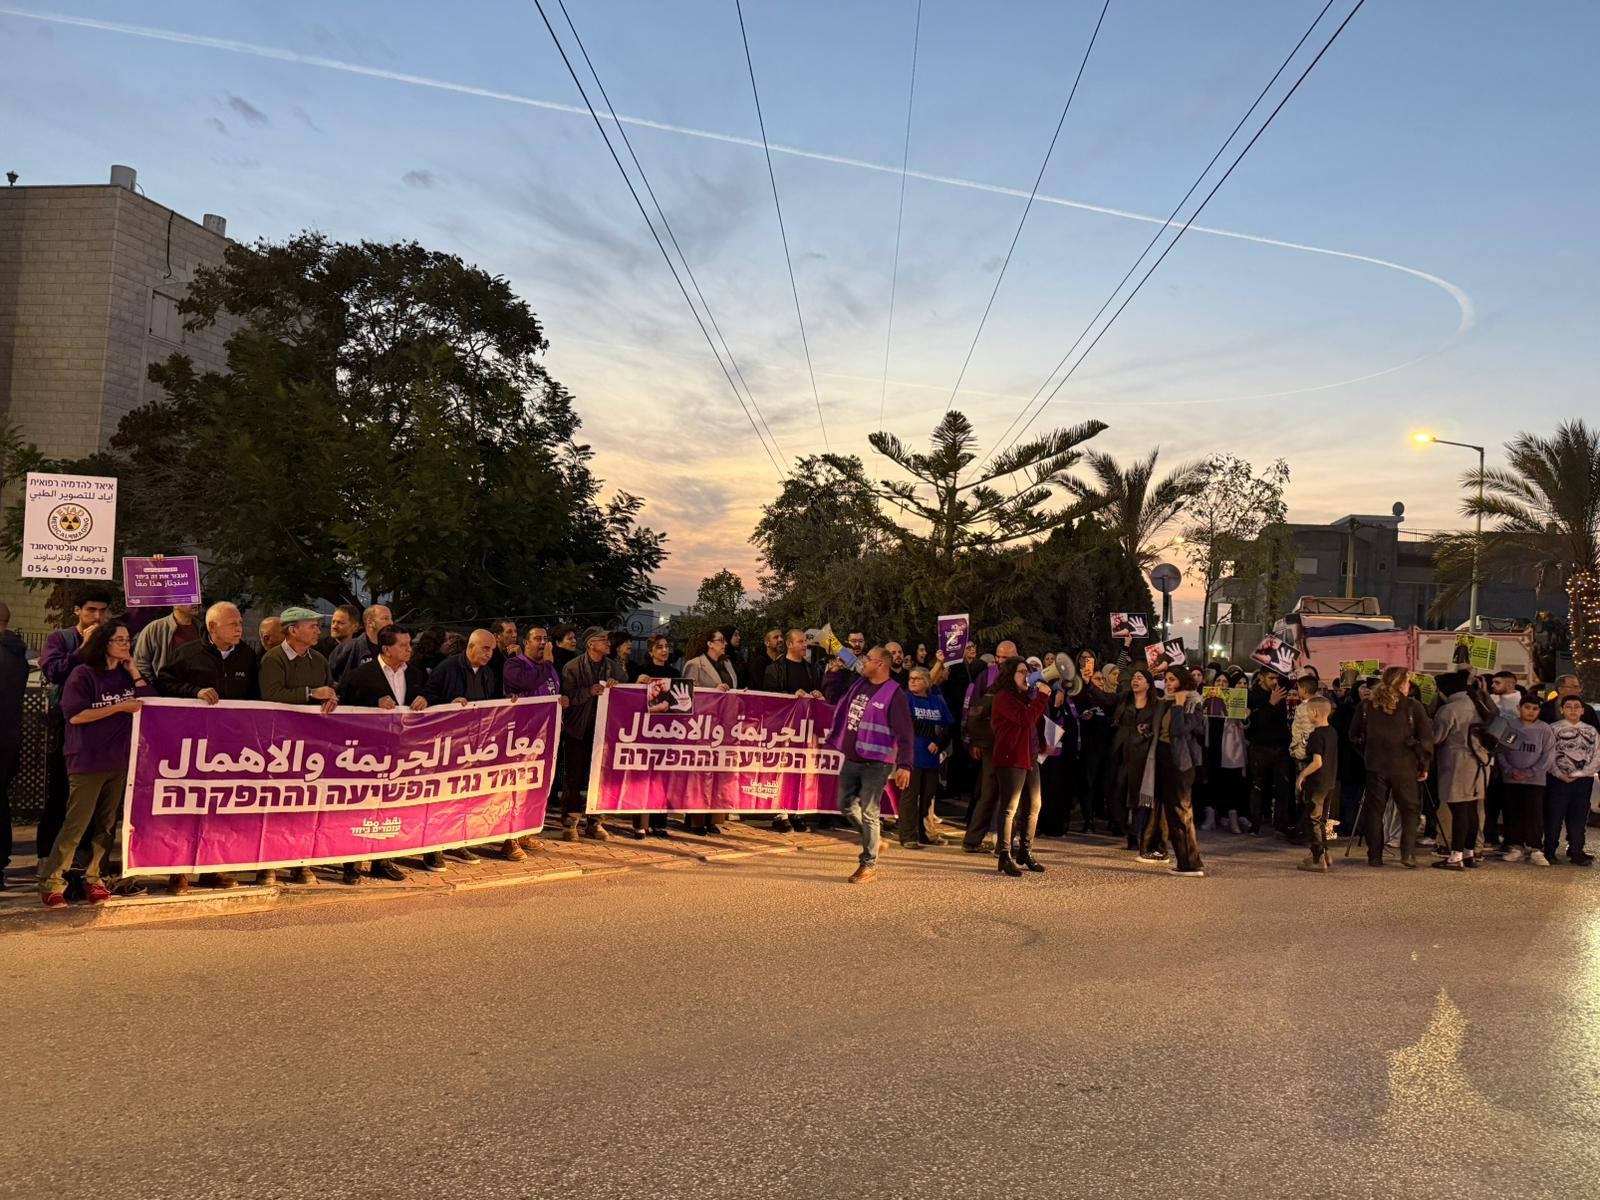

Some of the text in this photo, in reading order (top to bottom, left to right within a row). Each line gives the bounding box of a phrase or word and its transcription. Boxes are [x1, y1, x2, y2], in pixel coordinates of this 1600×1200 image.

[30, 478, 114, 490] איאד להדמיה רפואית
[30, 490, 56, 501] الطبي
[58, 492, 96, 500] للتصوير
[56, 506, 84, 516] EYAD
[51, 516, 90, 539] MEDICAL IMAGING
[30, 543, 108, 554] בדיקות אולטרסאונד
[618, 712, 725, 748] والاهمال
[730, 714, 814, 750] الجريمة
[158, 738, 326, 782] والاهمال
[335, 736, 452, 780] الجريمة
[456, 736, 498, 765] ضد
[619, 748, 840, 770] נגד הפשיעה וההפקרה
[162, 766, 538, 814] ביחד נגד הפשיעה וההפקרה
